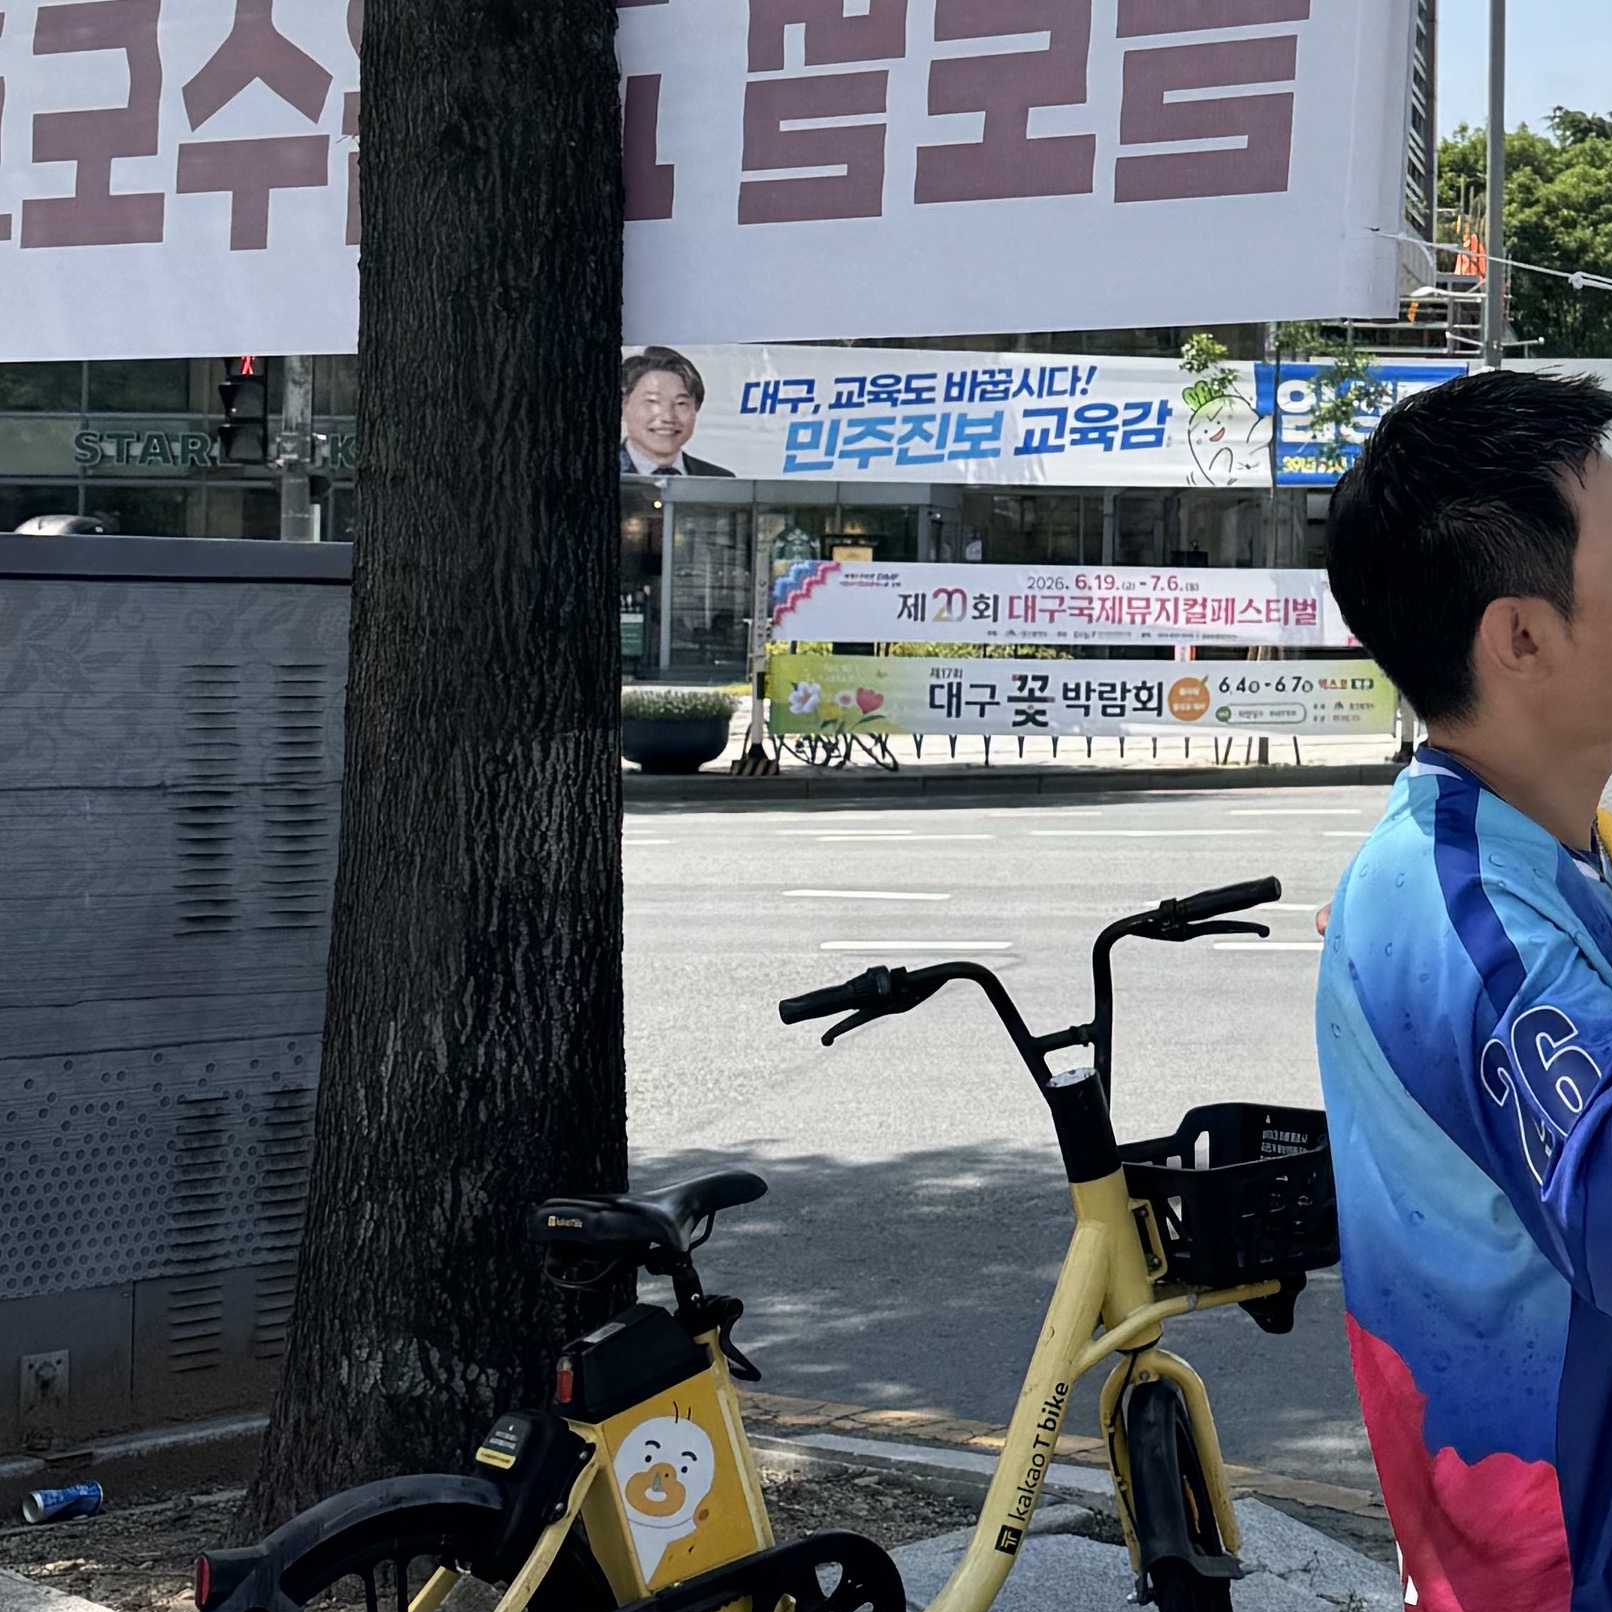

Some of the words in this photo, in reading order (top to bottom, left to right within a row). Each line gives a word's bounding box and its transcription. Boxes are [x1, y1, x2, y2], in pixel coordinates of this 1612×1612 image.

[740, 379, 821, 416] 대구,
[829, 372, 937, 410] 교육도
[945, 364, 1098, 402] 바꿉시다!
[782, 410, 1005, 473] 민주진보
[1013, 399, 1173, 455] 교육감
[1027, 577, 1070, 591] 2026.
[1008, 594, 1318, 627] 대구국제뮤지컬페스티벌
[930, 666, 964, 679] 제17회
[929, 681, 1000, 719] 대구
[1006, 673, 1056, 728] 꽃
[1062, 680, 1164, 718] 박람회
[1037, 1381, 1070, 1433] bike
[1033, 1433, 1051, 1449] T
[1008, 1453, 1046, 1522] kakao
